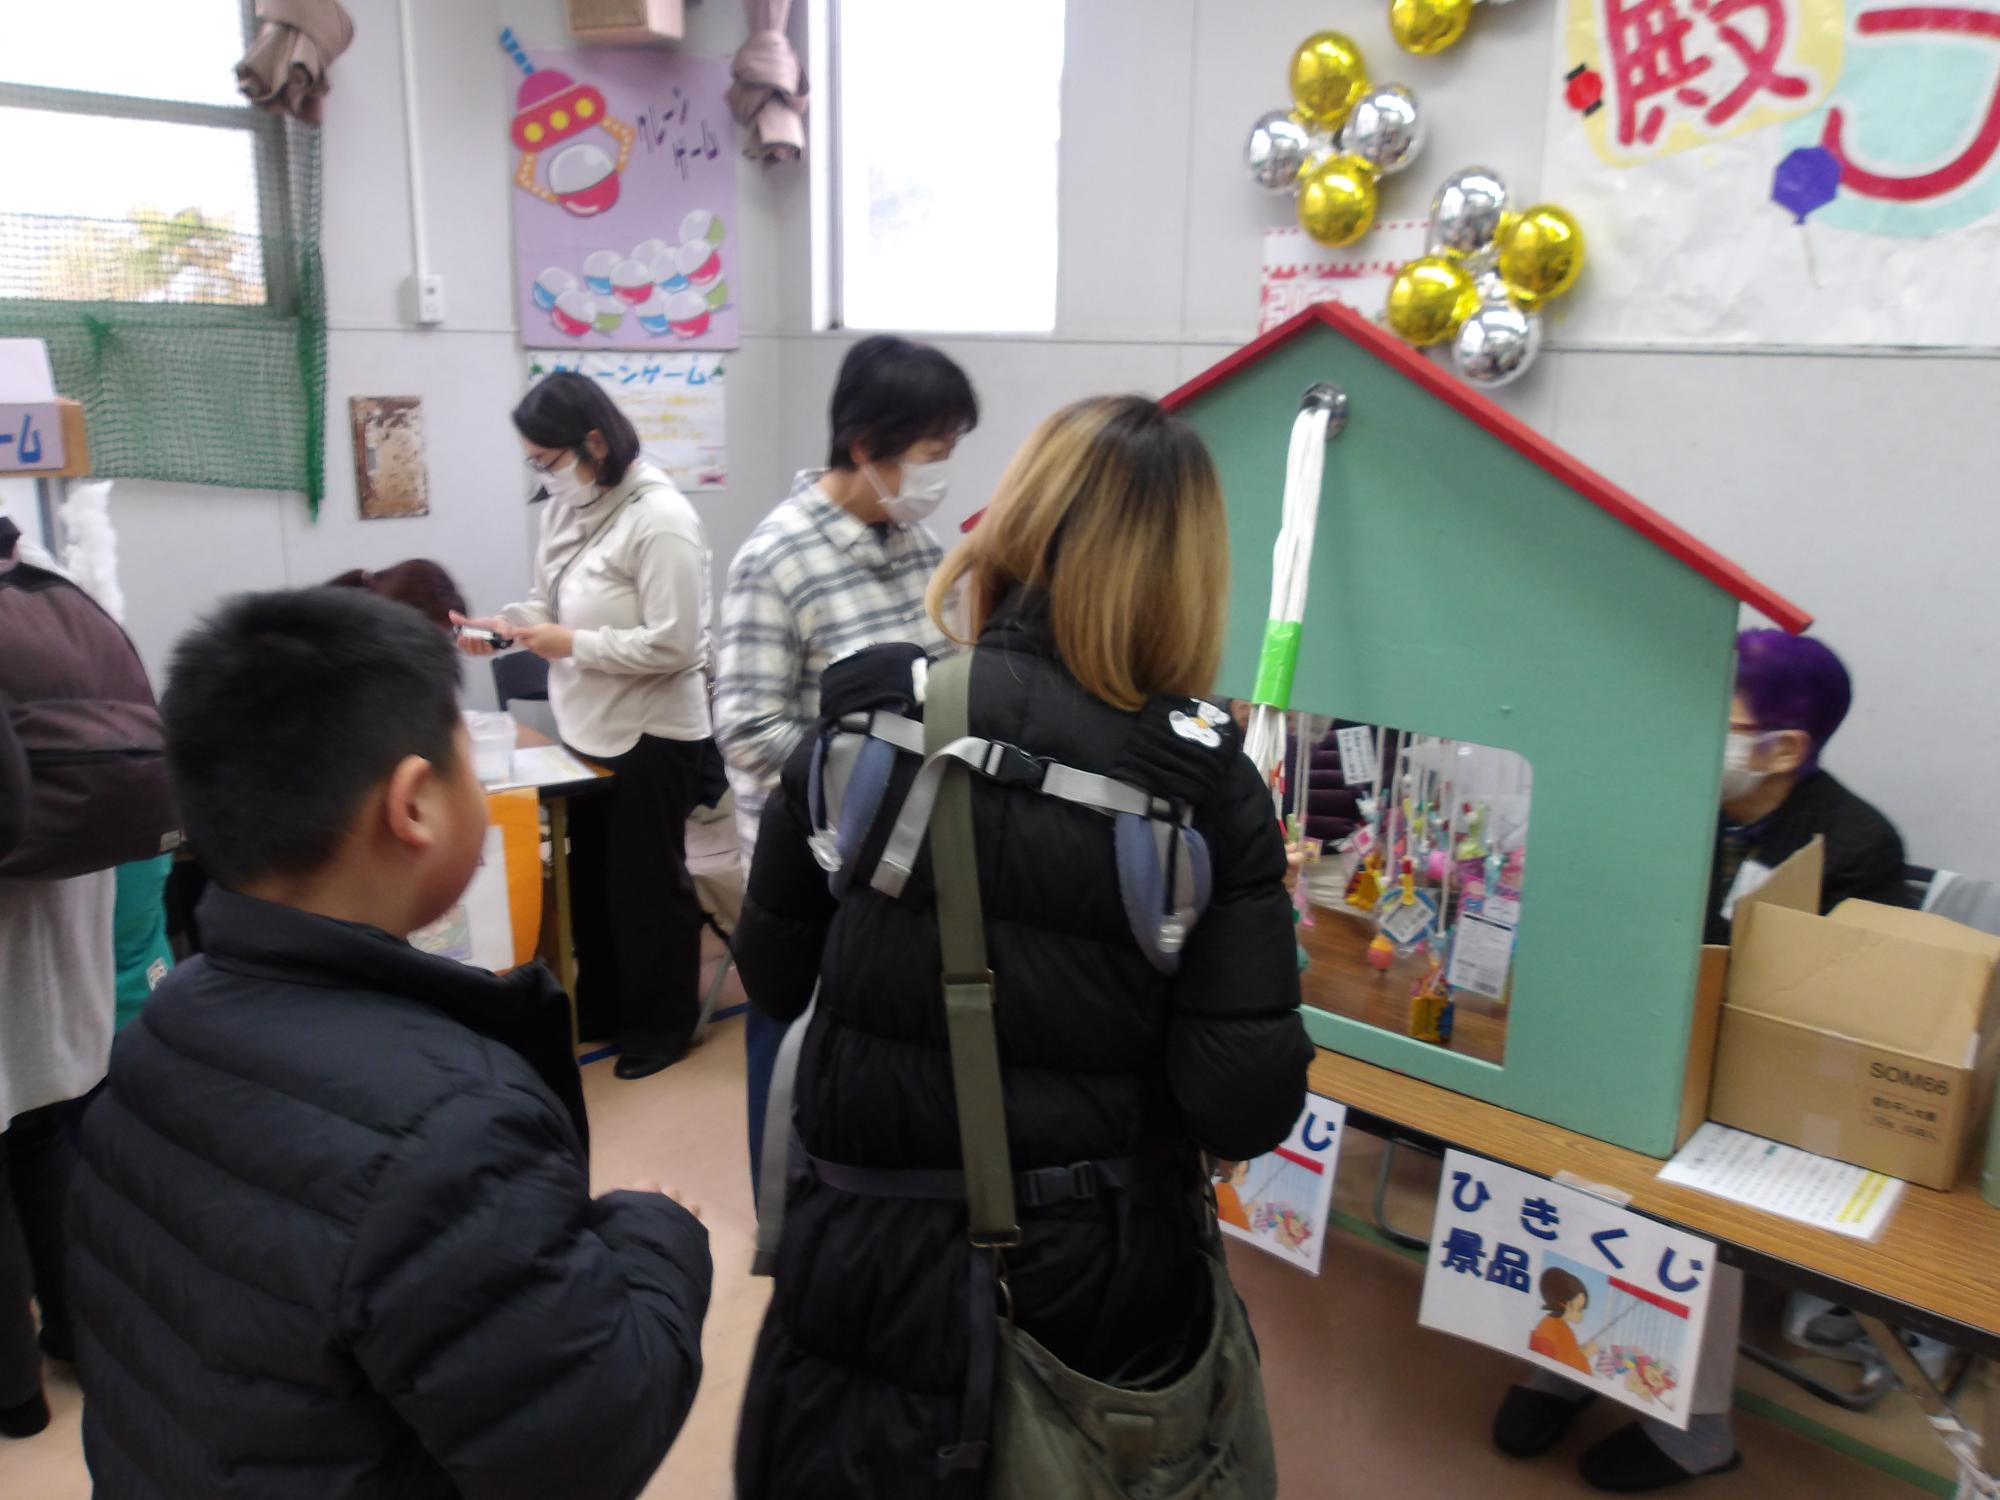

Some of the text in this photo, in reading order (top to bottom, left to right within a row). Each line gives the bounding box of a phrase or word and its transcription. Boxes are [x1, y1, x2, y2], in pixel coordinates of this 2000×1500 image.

[1441, 1226, 1531, 1294] 景品
[1452, 1170, 1704, 1293] ひきくじ
